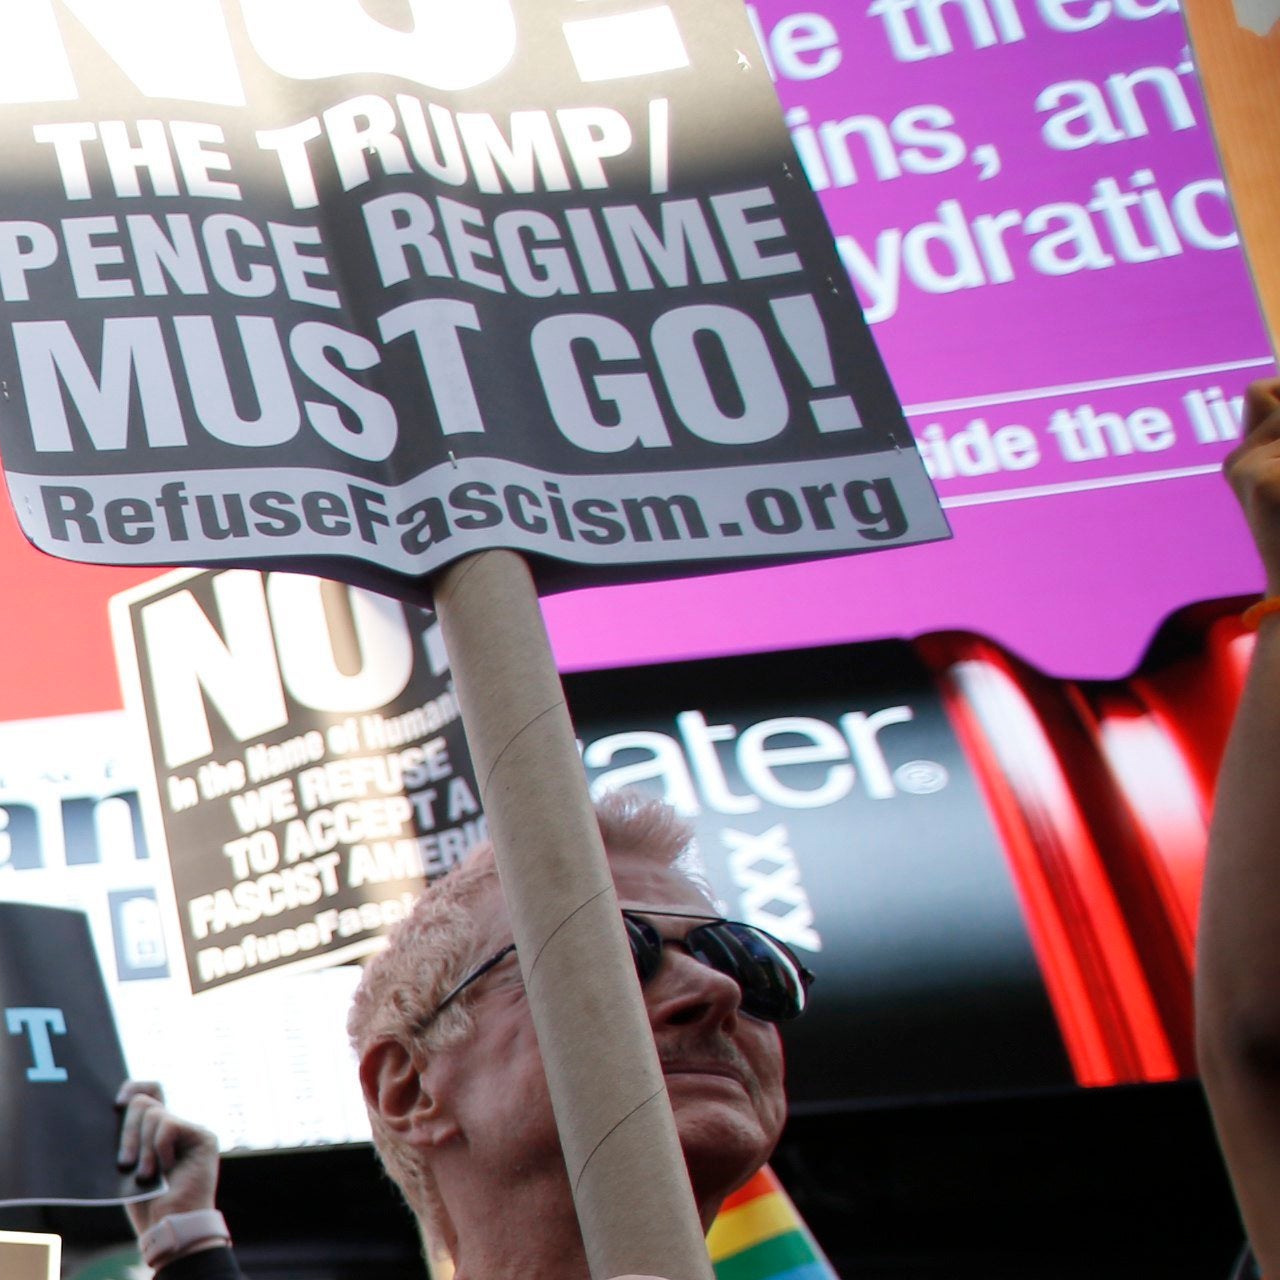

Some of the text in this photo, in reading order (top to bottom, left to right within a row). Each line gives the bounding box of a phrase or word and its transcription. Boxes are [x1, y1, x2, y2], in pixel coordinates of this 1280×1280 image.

[33, 93, 671, 209] THE TRUMP/
[1033, 45, 1197, 152] an
[361, 187, 804, 297] REGIME
[11, 294, 864, 463] MUST GO!
[1046, 404, 1176, 463] the
[41, 477, 909, 558] RefuseFascism.org
[142, 569, 450, 769] NO
[230, 736, 454, 834] WE REFUSE
[576, 706, 914, 817] ater
[189, 815, 490, 940] FASCIST AMERI
[223, 776, 478, 882] TO ACCEPT A
